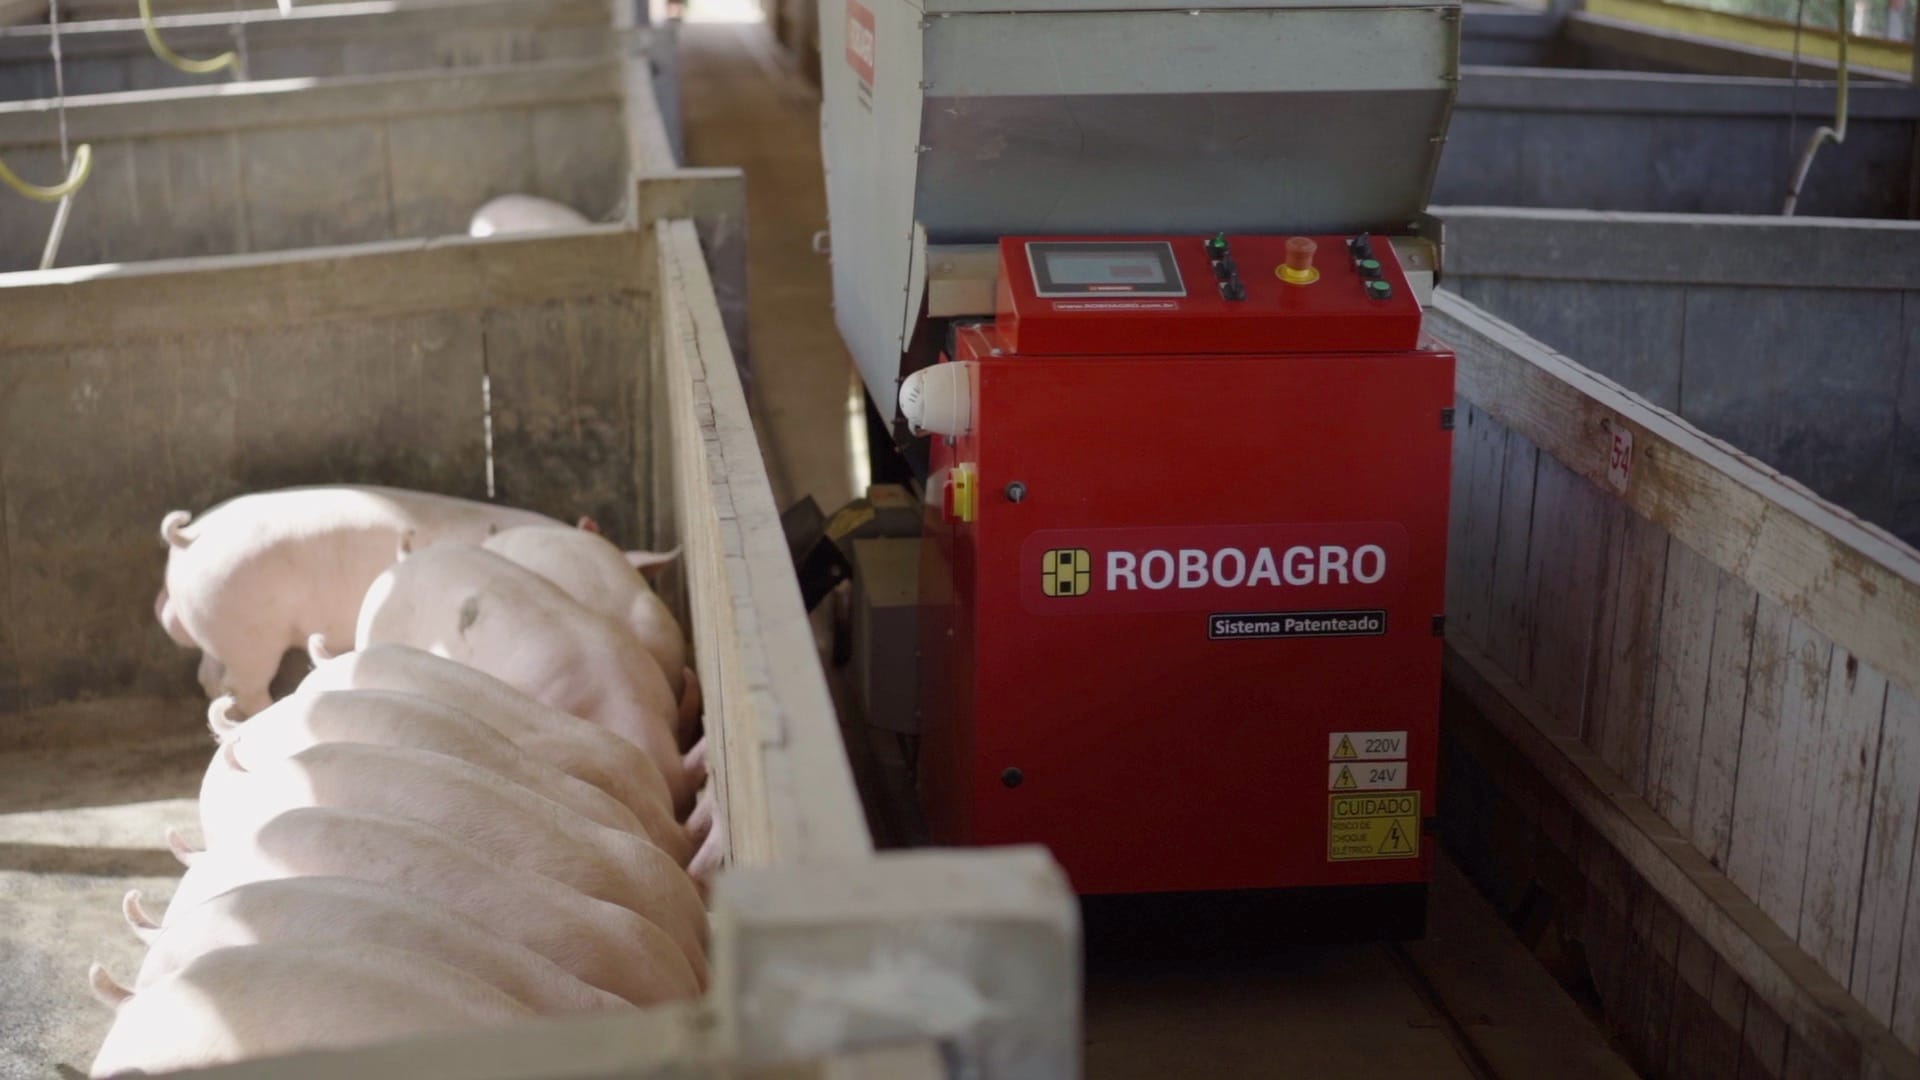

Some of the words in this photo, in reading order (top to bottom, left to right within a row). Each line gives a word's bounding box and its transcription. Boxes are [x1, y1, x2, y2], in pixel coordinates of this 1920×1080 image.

[1611, 434, 1630, 479] 54
[1105, 544, 1387, 591] ROBOAGRO
[1215, 619, 1280, 634] Sistema
[1284, 616, 1379, 632] Patenteado
[1365, 738, 1401, 753] 220V
[1369, 768, 1397, 783] 24V
[1336, 798, 1412, 816] CUIDADO
